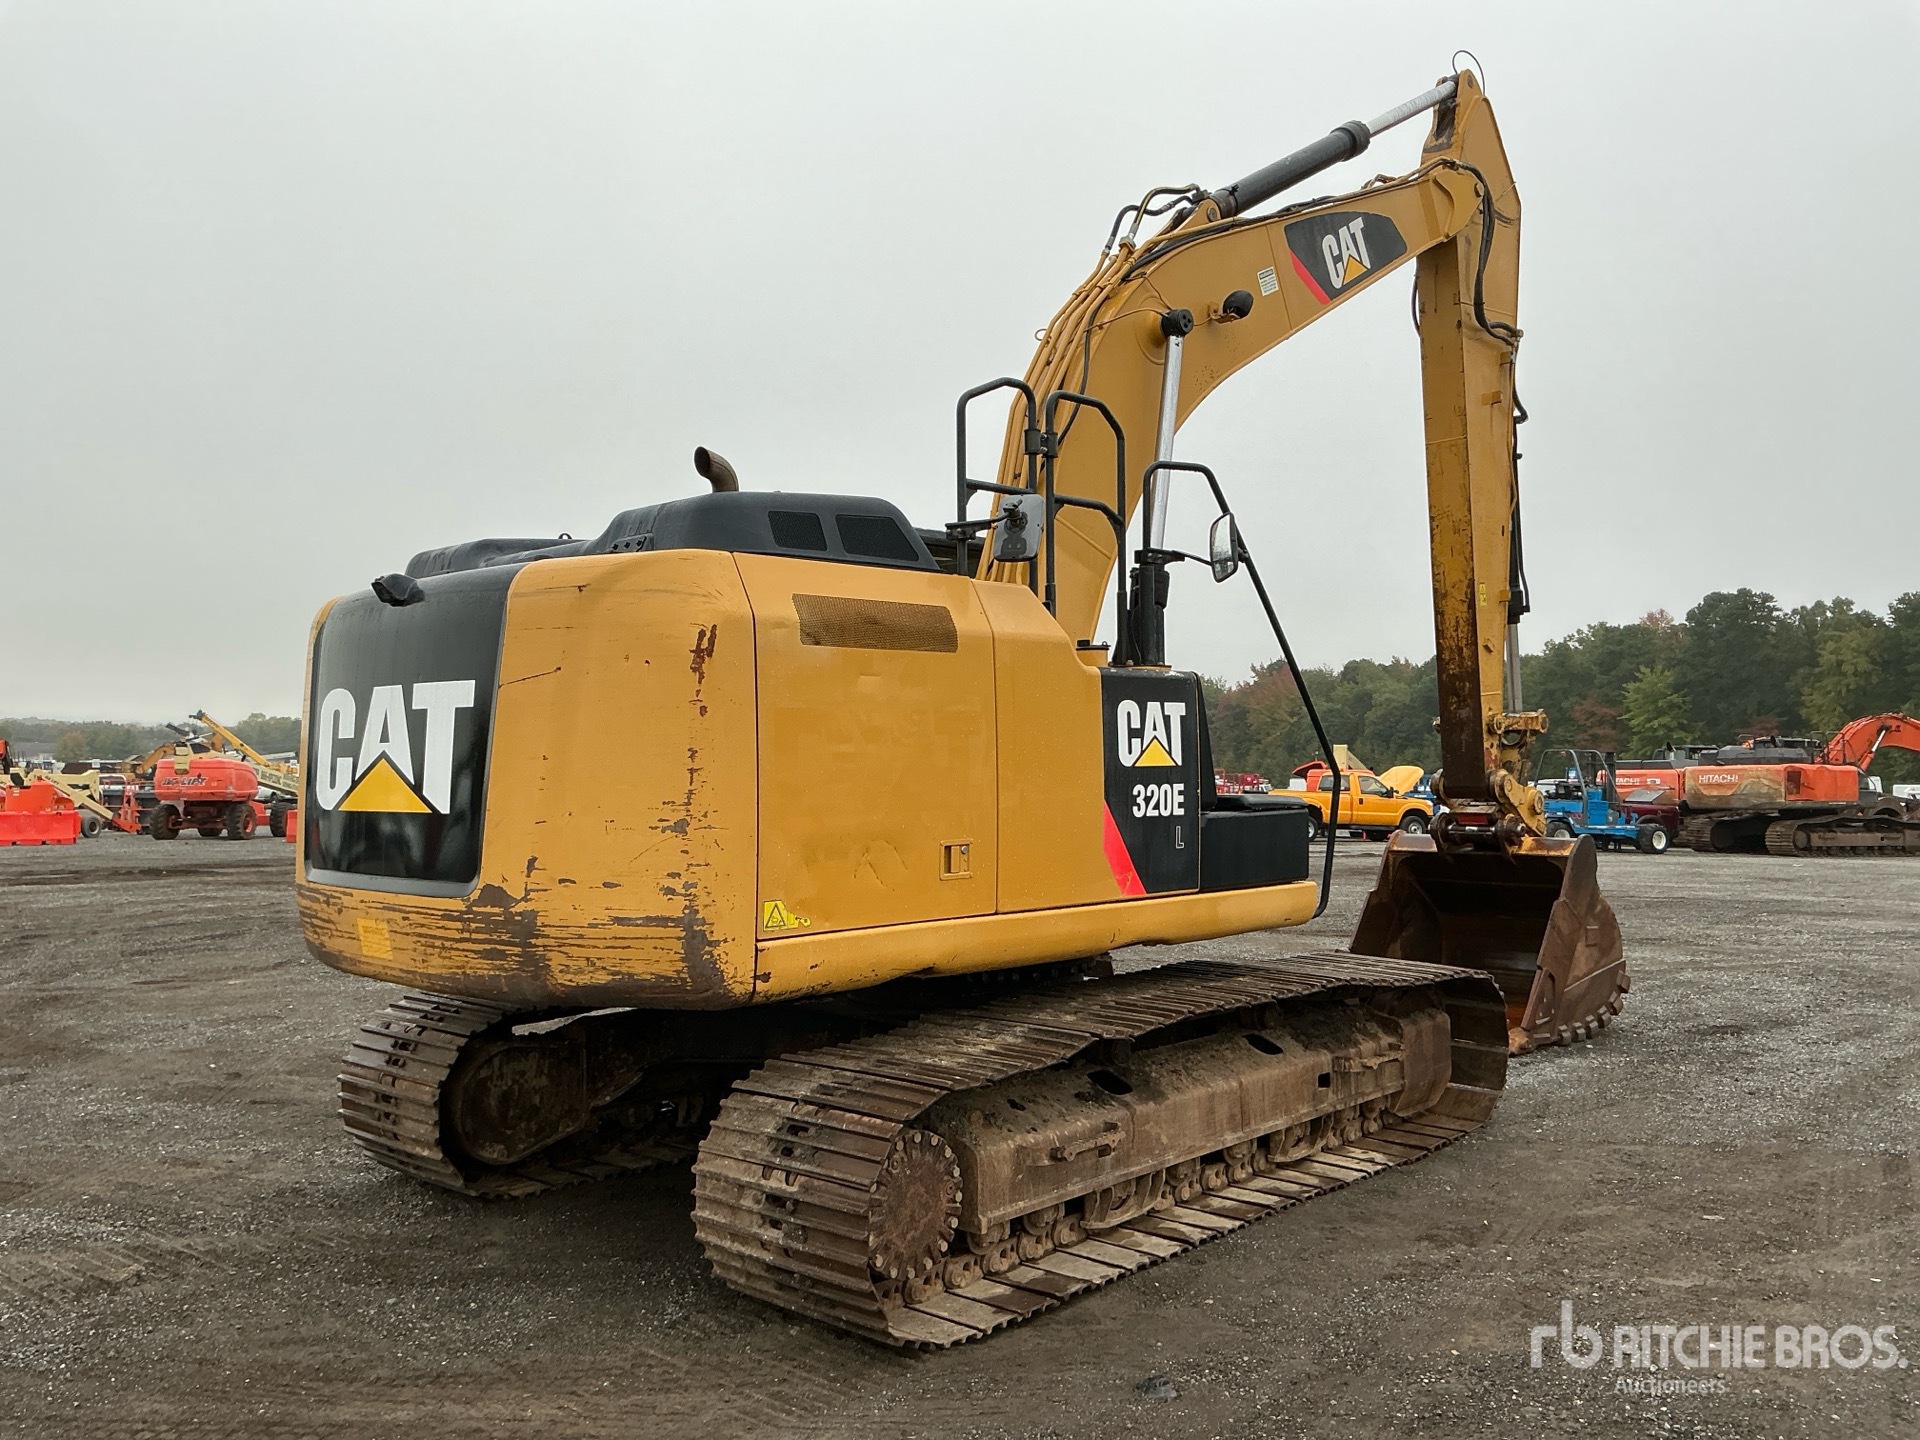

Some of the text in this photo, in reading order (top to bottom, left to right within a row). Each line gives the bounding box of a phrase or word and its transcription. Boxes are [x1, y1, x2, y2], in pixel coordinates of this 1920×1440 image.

[1322, 217, 1371, 289] CAT
[316, 680, 476, 815] CAT
[1117, 699, 1186, 767] CAT
[1132, 783, 1185, 818] 320E
[1699, 774, 1739, 784] HITACHI
[1175, 826, 1185, 849] L
